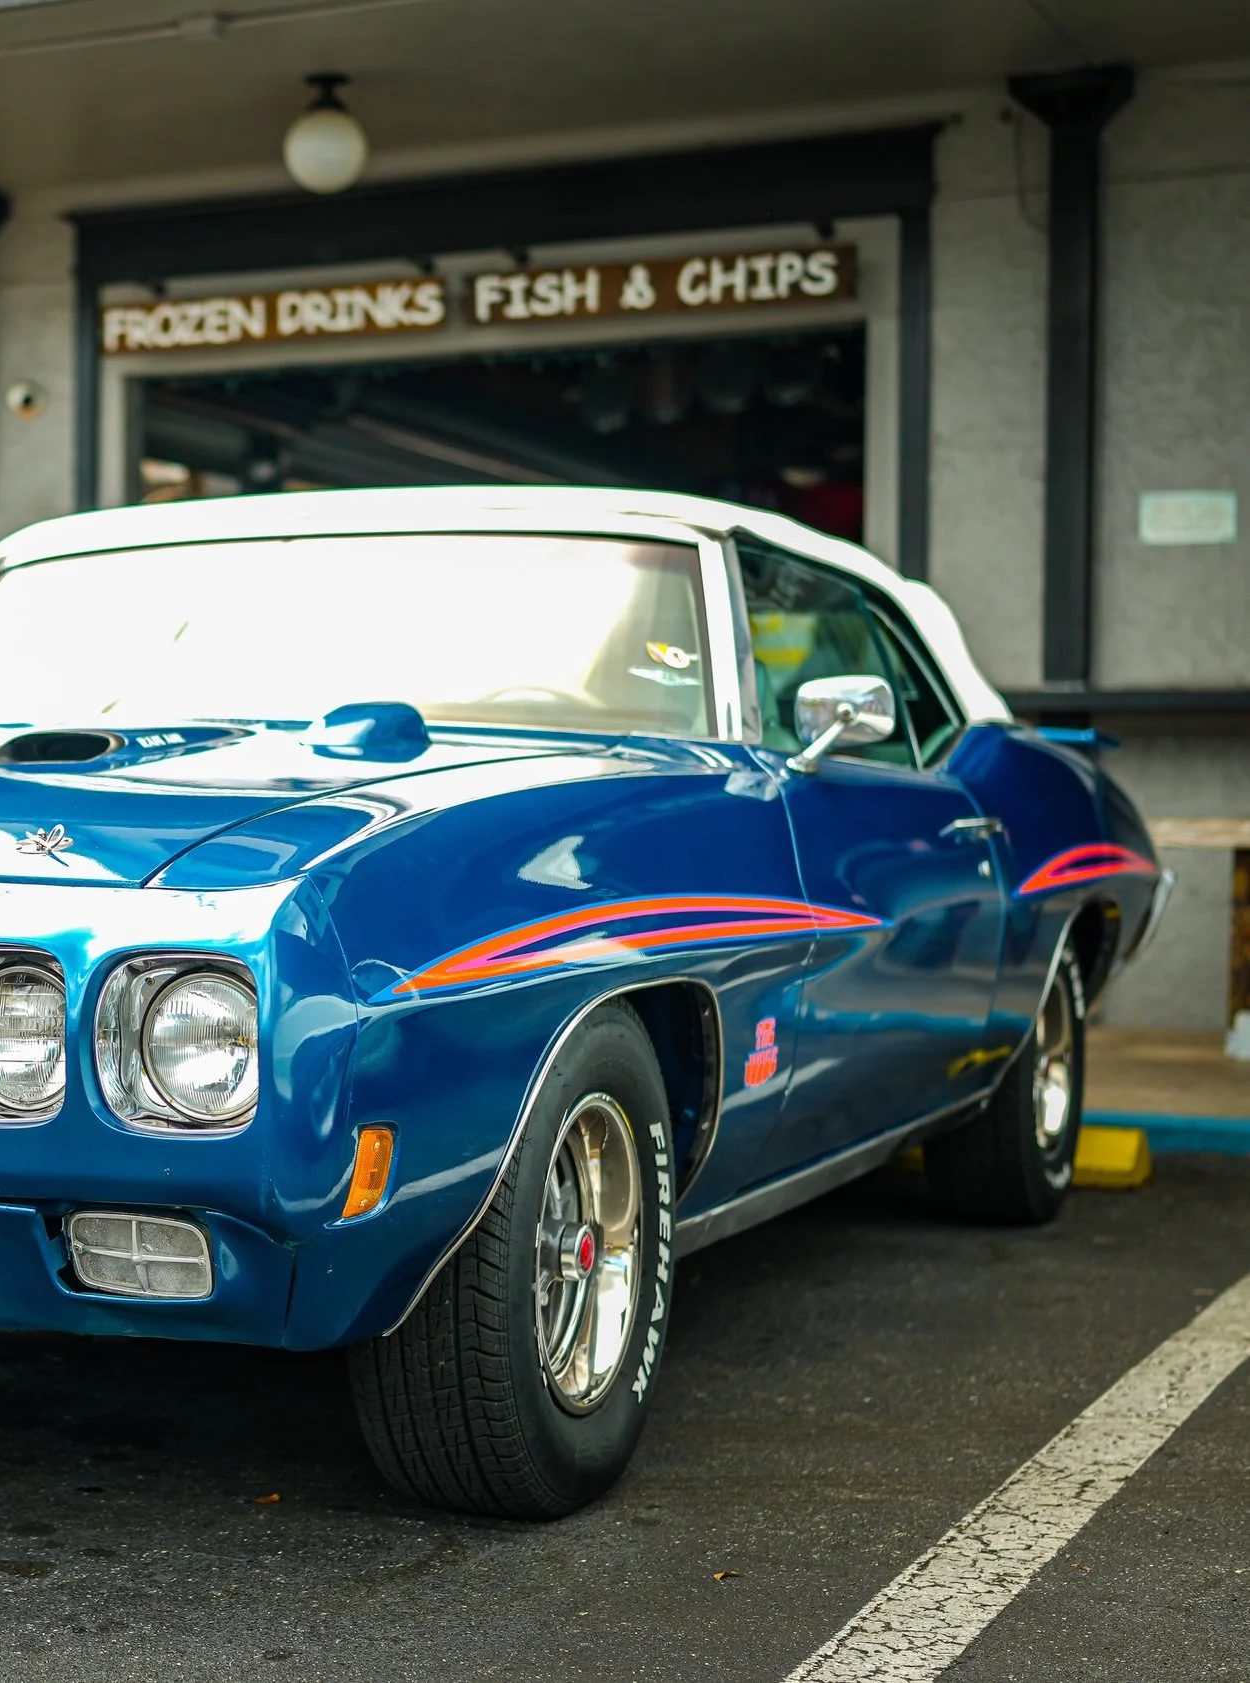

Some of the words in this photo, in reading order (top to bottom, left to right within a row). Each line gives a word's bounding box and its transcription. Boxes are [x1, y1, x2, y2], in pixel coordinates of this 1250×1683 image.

[104, 296, 267, 352] FROZEN
[277, 283, 445, 336] DRINKS
[474, 267, 600, 323] FISH
[620, 263, 657, 311] &
[676, 250, 839, 307] CHIPS
[632, 1121, 671, 1404] FIREHAWK
